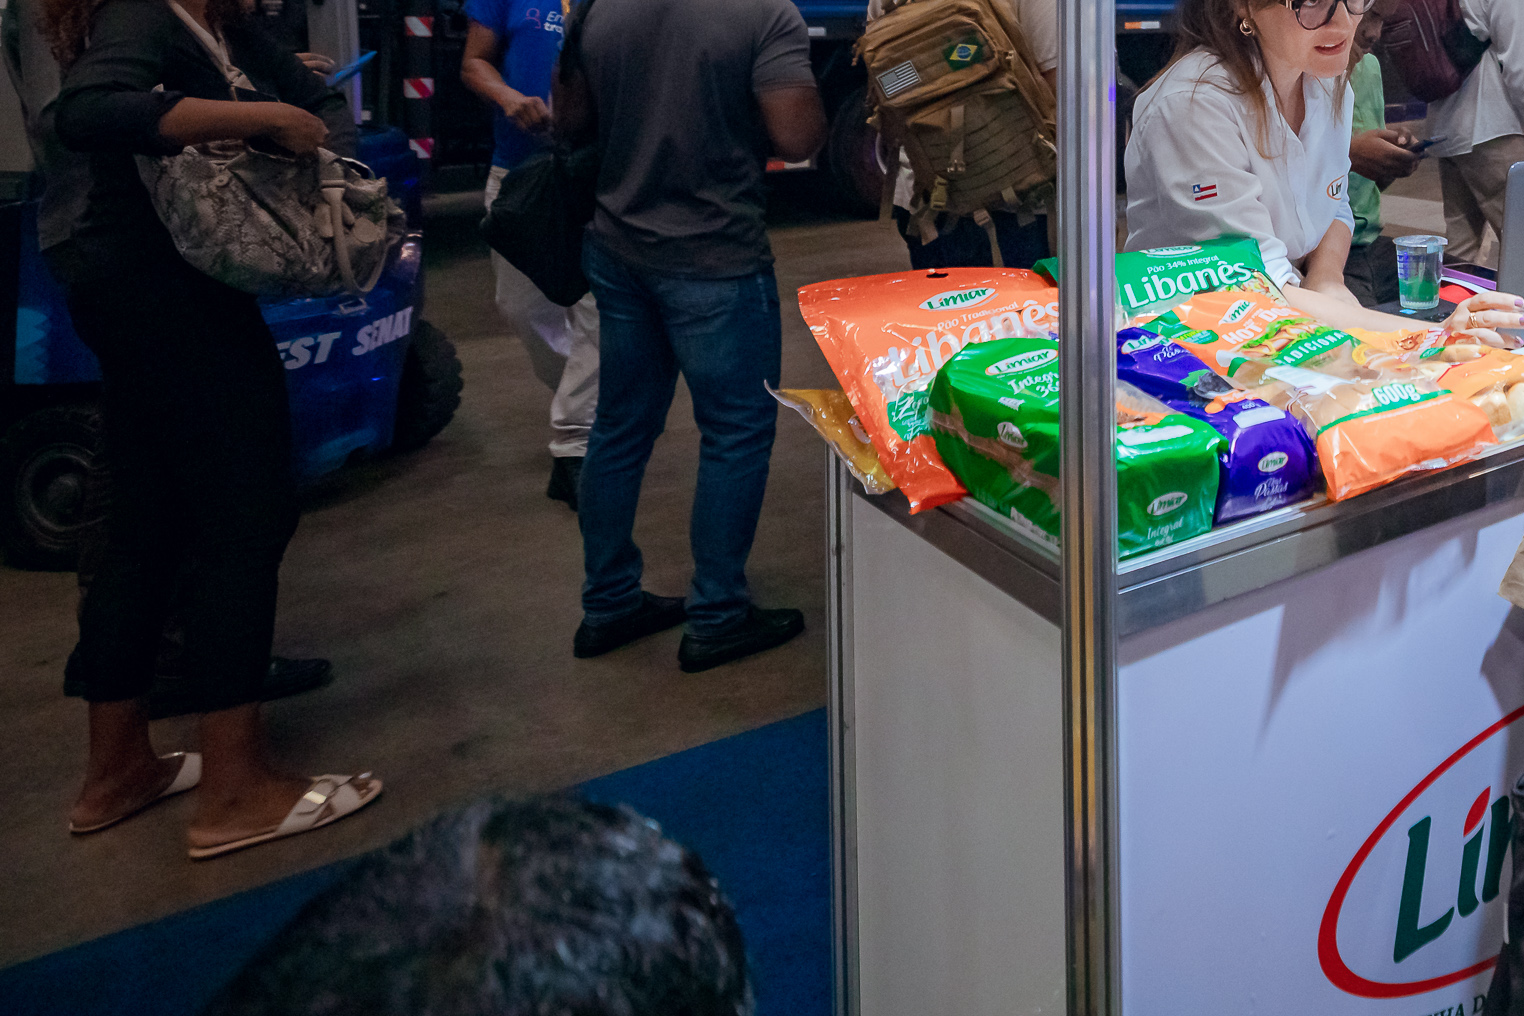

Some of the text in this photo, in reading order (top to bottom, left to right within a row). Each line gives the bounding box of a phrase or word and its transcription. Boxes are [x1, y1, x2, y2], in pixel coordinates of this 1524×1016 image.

[1147, 265, 1166, 275] Pão
[1187, 254, 1220, 266] Integral
[1124, 260, 1251, 309] Libanês
[927, 287, 990, 310] Limiar
[937, 301, 1019, 332] Pão Tradicional
[352, 305, 414, 356] SENAT
[1221, 321, 1263, 345] HOT
[887, 299, 1059, 388] Libanês
[994, 350, 1049, 373] Limiar
[1372, 383, 1421, 406] 600g
